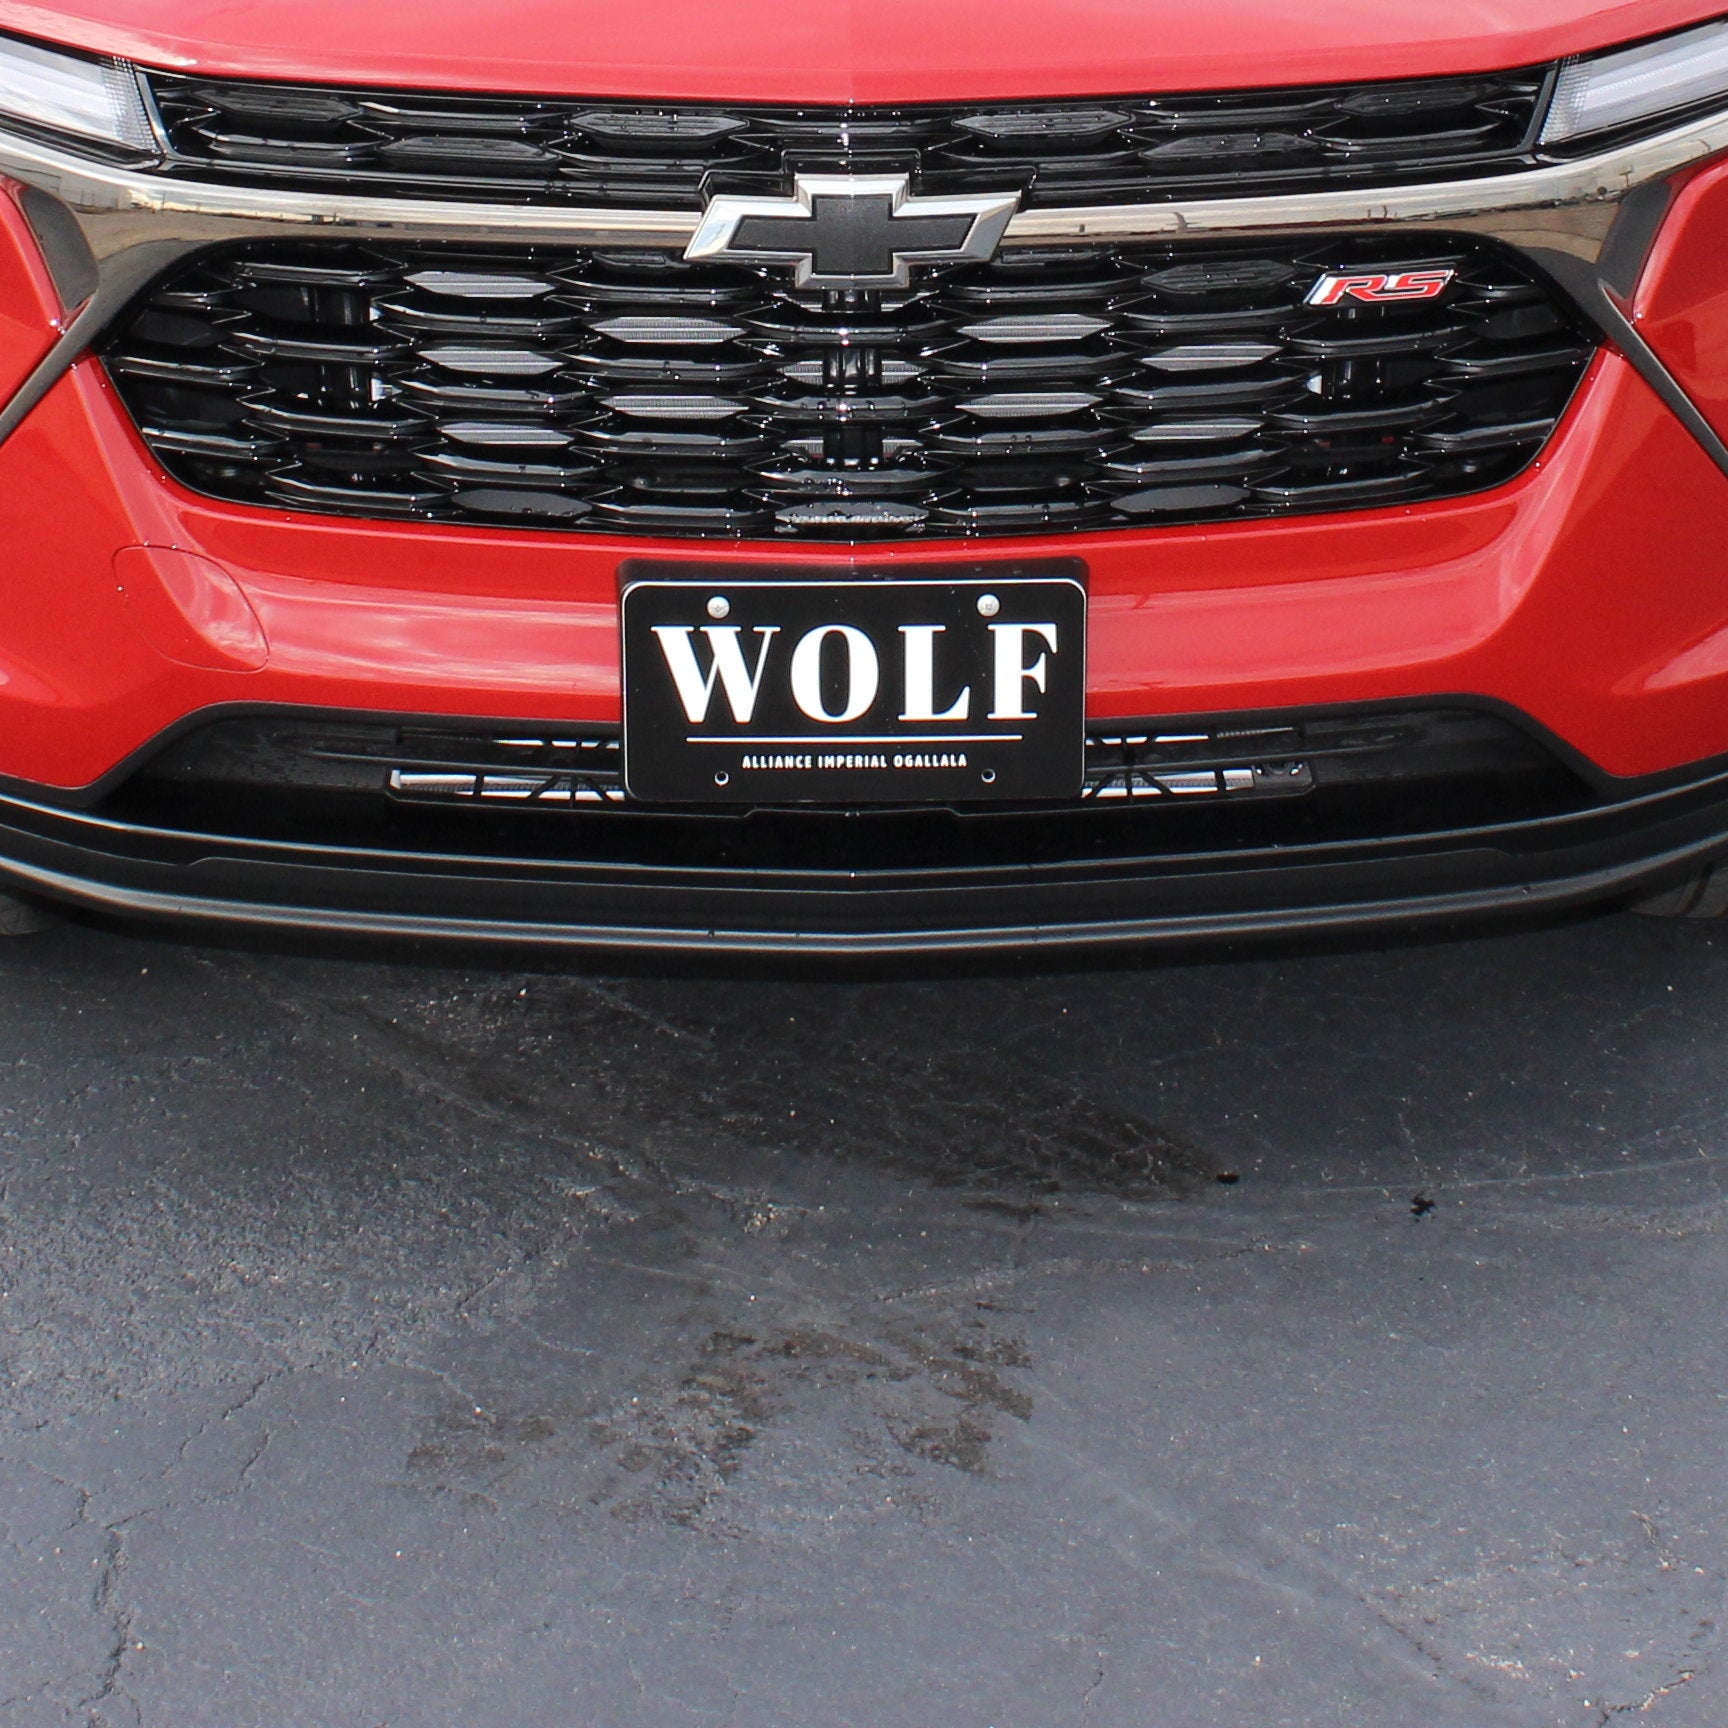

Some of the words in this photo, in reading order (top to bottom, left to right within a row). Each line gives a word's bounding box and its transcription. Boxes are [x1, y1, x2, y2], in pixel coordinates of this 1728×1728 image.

[1308, 269, 1455, 305] RS
[651, 623, 1058, 723] WOLF
[741, 755, 813, 769] ALLIANCE
[818, 754, 888, 769] IMPERIAL
[892, 753, 968, 768] OGALLALA
